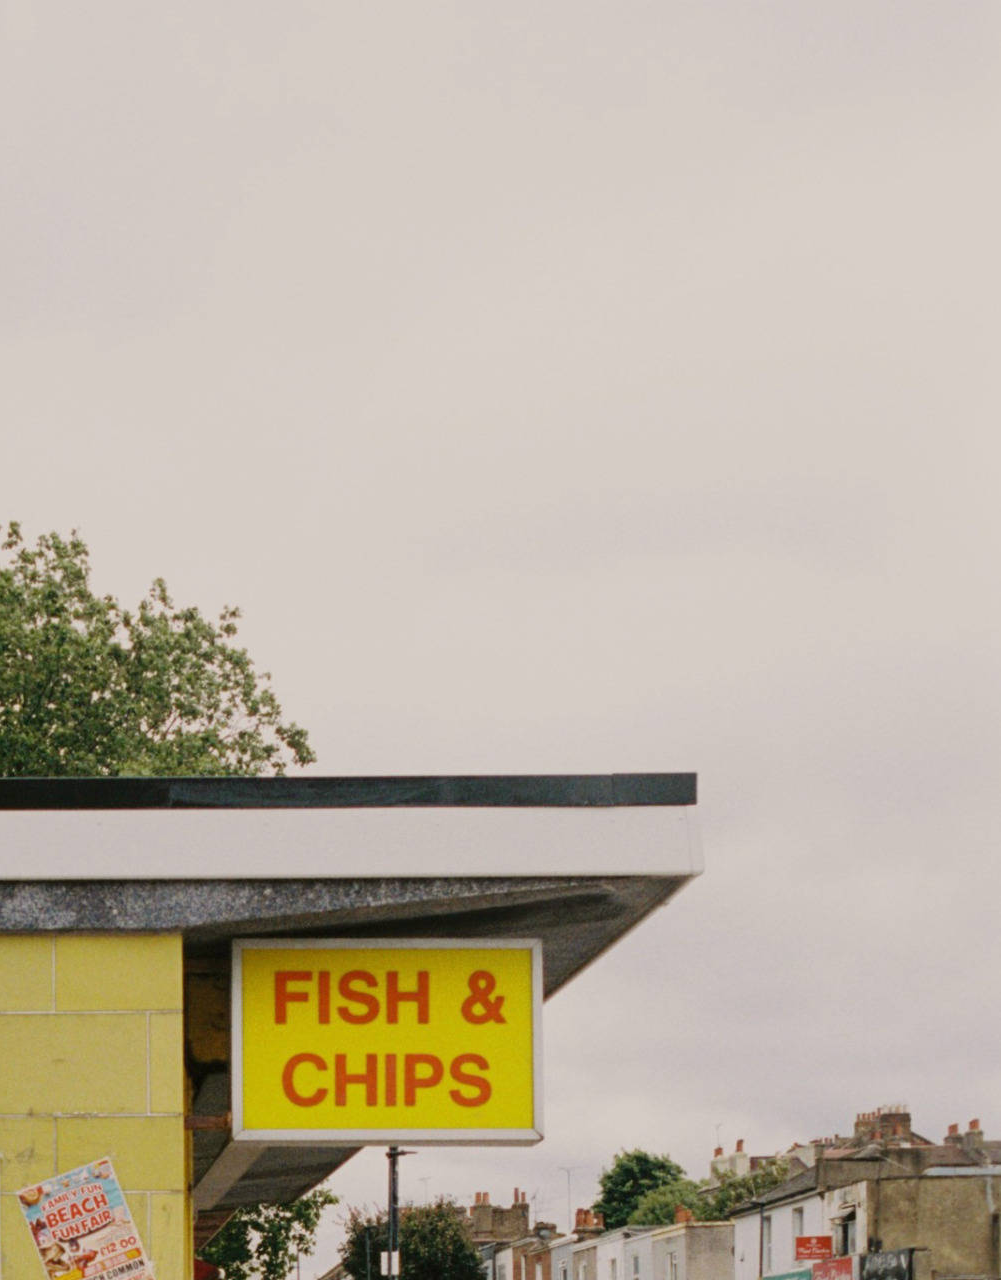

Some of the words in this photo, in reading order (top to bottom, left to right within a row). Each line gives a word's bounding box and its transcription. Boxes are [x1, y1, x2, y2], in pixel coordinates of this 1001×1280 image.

[274, 970, 430, 1025] FISH
[460, 970, 507, 1025] &
[282, 1053, 492, 1107] CHIPS
[41, 1189, 77, 1212] FAMILY
[80, 1183, 101, 1195] FUN
[44, 1192, 108, 1228] BEACH
[105, 1257, 145, 1280] COMMON
